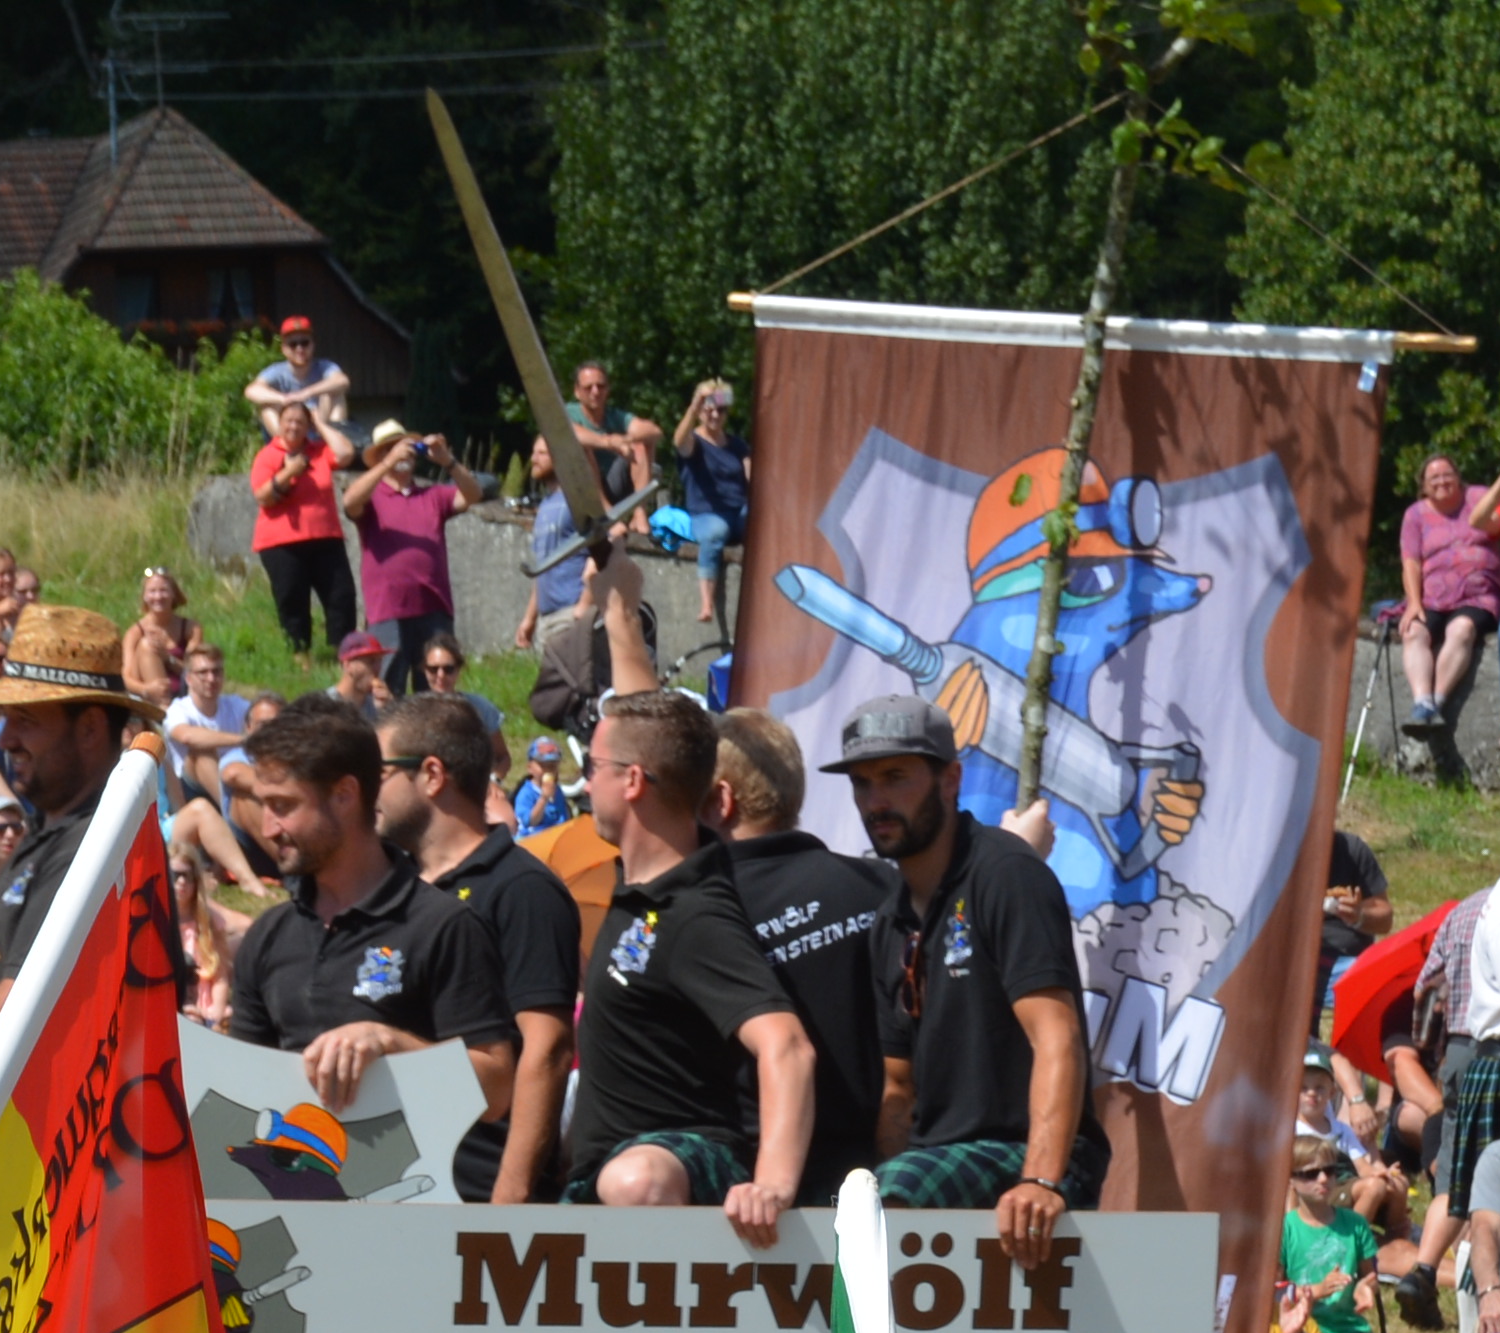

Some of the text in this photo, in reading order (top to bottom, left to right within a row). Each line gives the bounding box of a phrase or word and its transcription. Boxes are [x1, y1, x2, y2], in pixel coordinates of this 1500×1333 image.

[22, 664, 109, 689] MALLORCA
[753, 900, 821, 940] RWÖLF
[453, 1231, 1083, 1331] Murwölf
